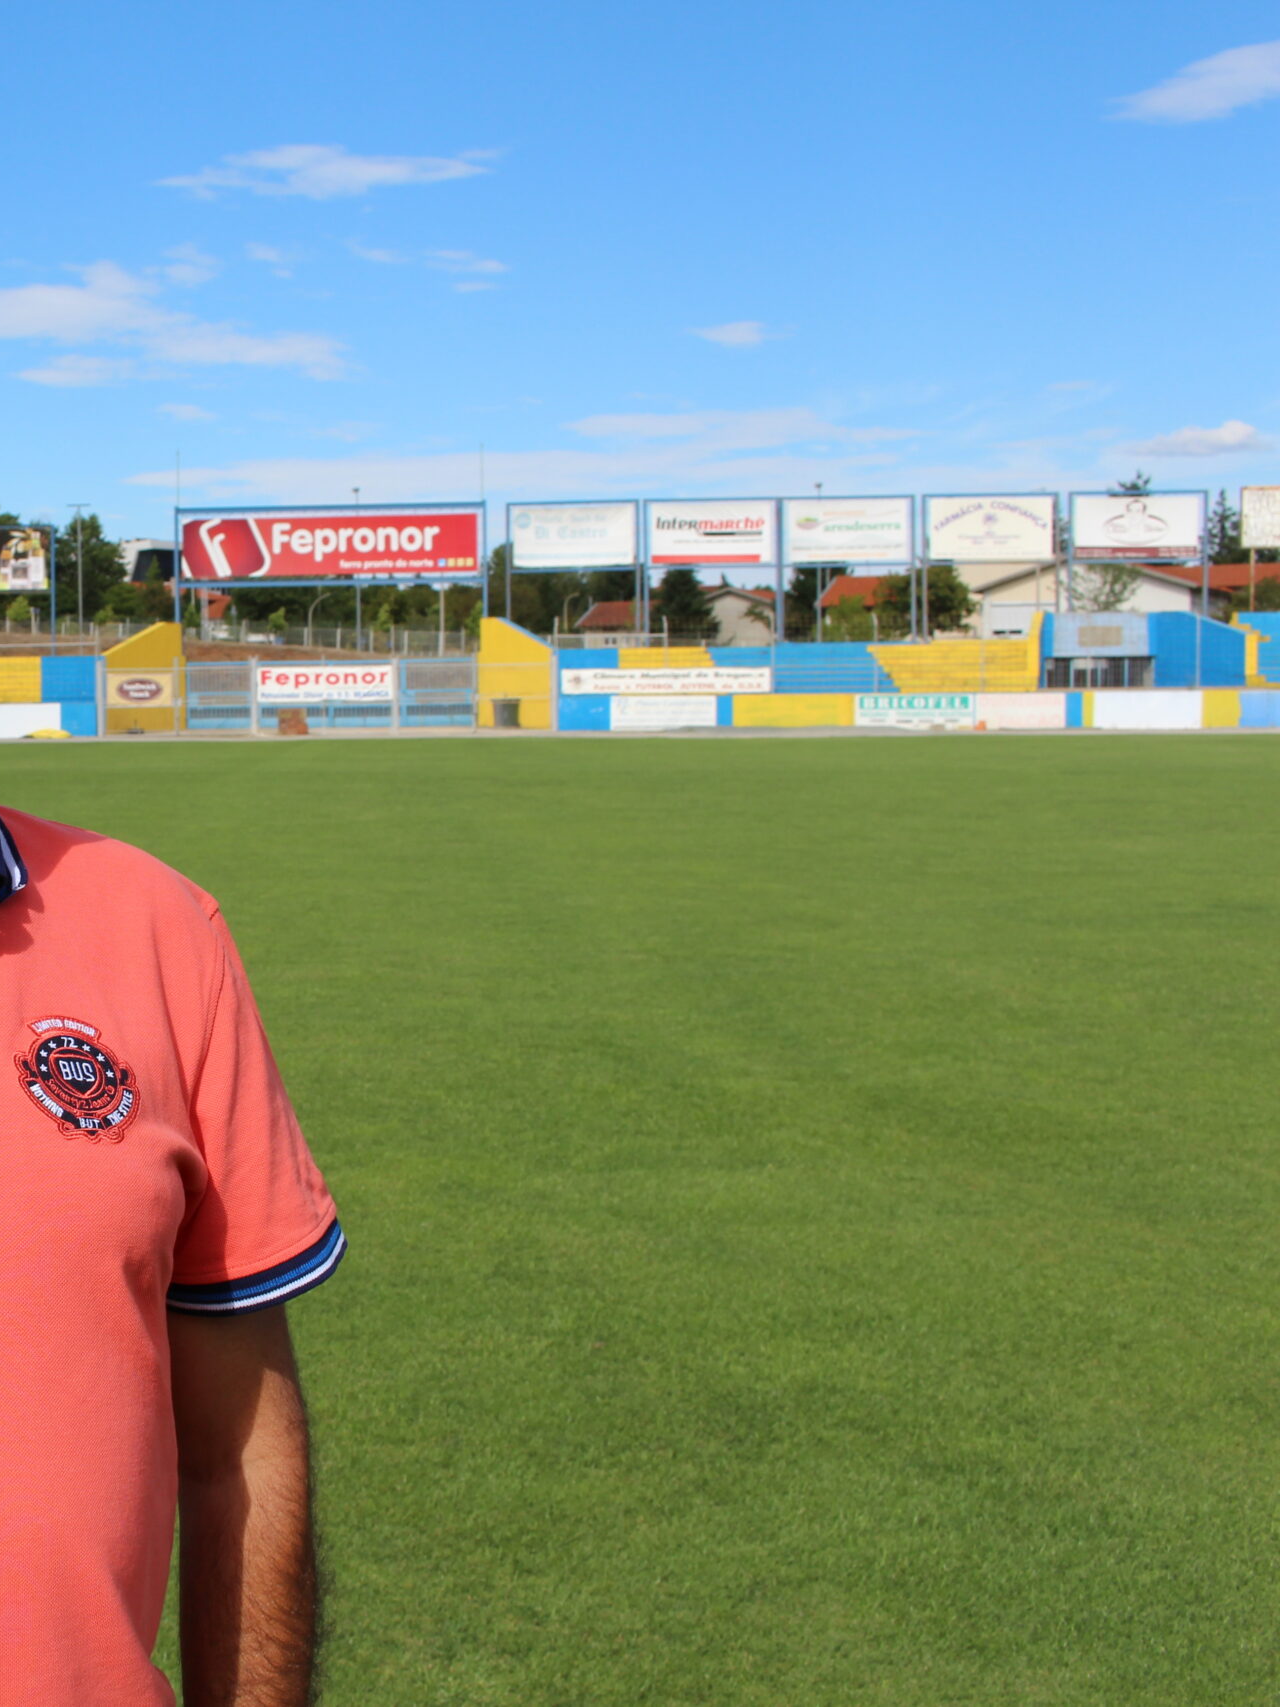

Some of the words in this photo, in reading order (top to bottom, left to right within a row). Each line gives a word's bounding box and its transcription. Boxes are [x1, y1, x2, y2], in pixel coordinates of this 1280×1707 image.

[272, 522, 440, 562] Fepronor
[260, 670, 389, 689] Fepronor
[32, 1018, 63, 1032] LIMITED
[64, 1019, 97, 1037] EDITION
[61, 1036, 78, 1048] 72
[59, 1060, 95, 1082] BUS
[29, 1083, 64, 1118] NOTHING
[118, 1090, 134, 1116] STYLE
[79, 1118, 100, 1129] BUT
